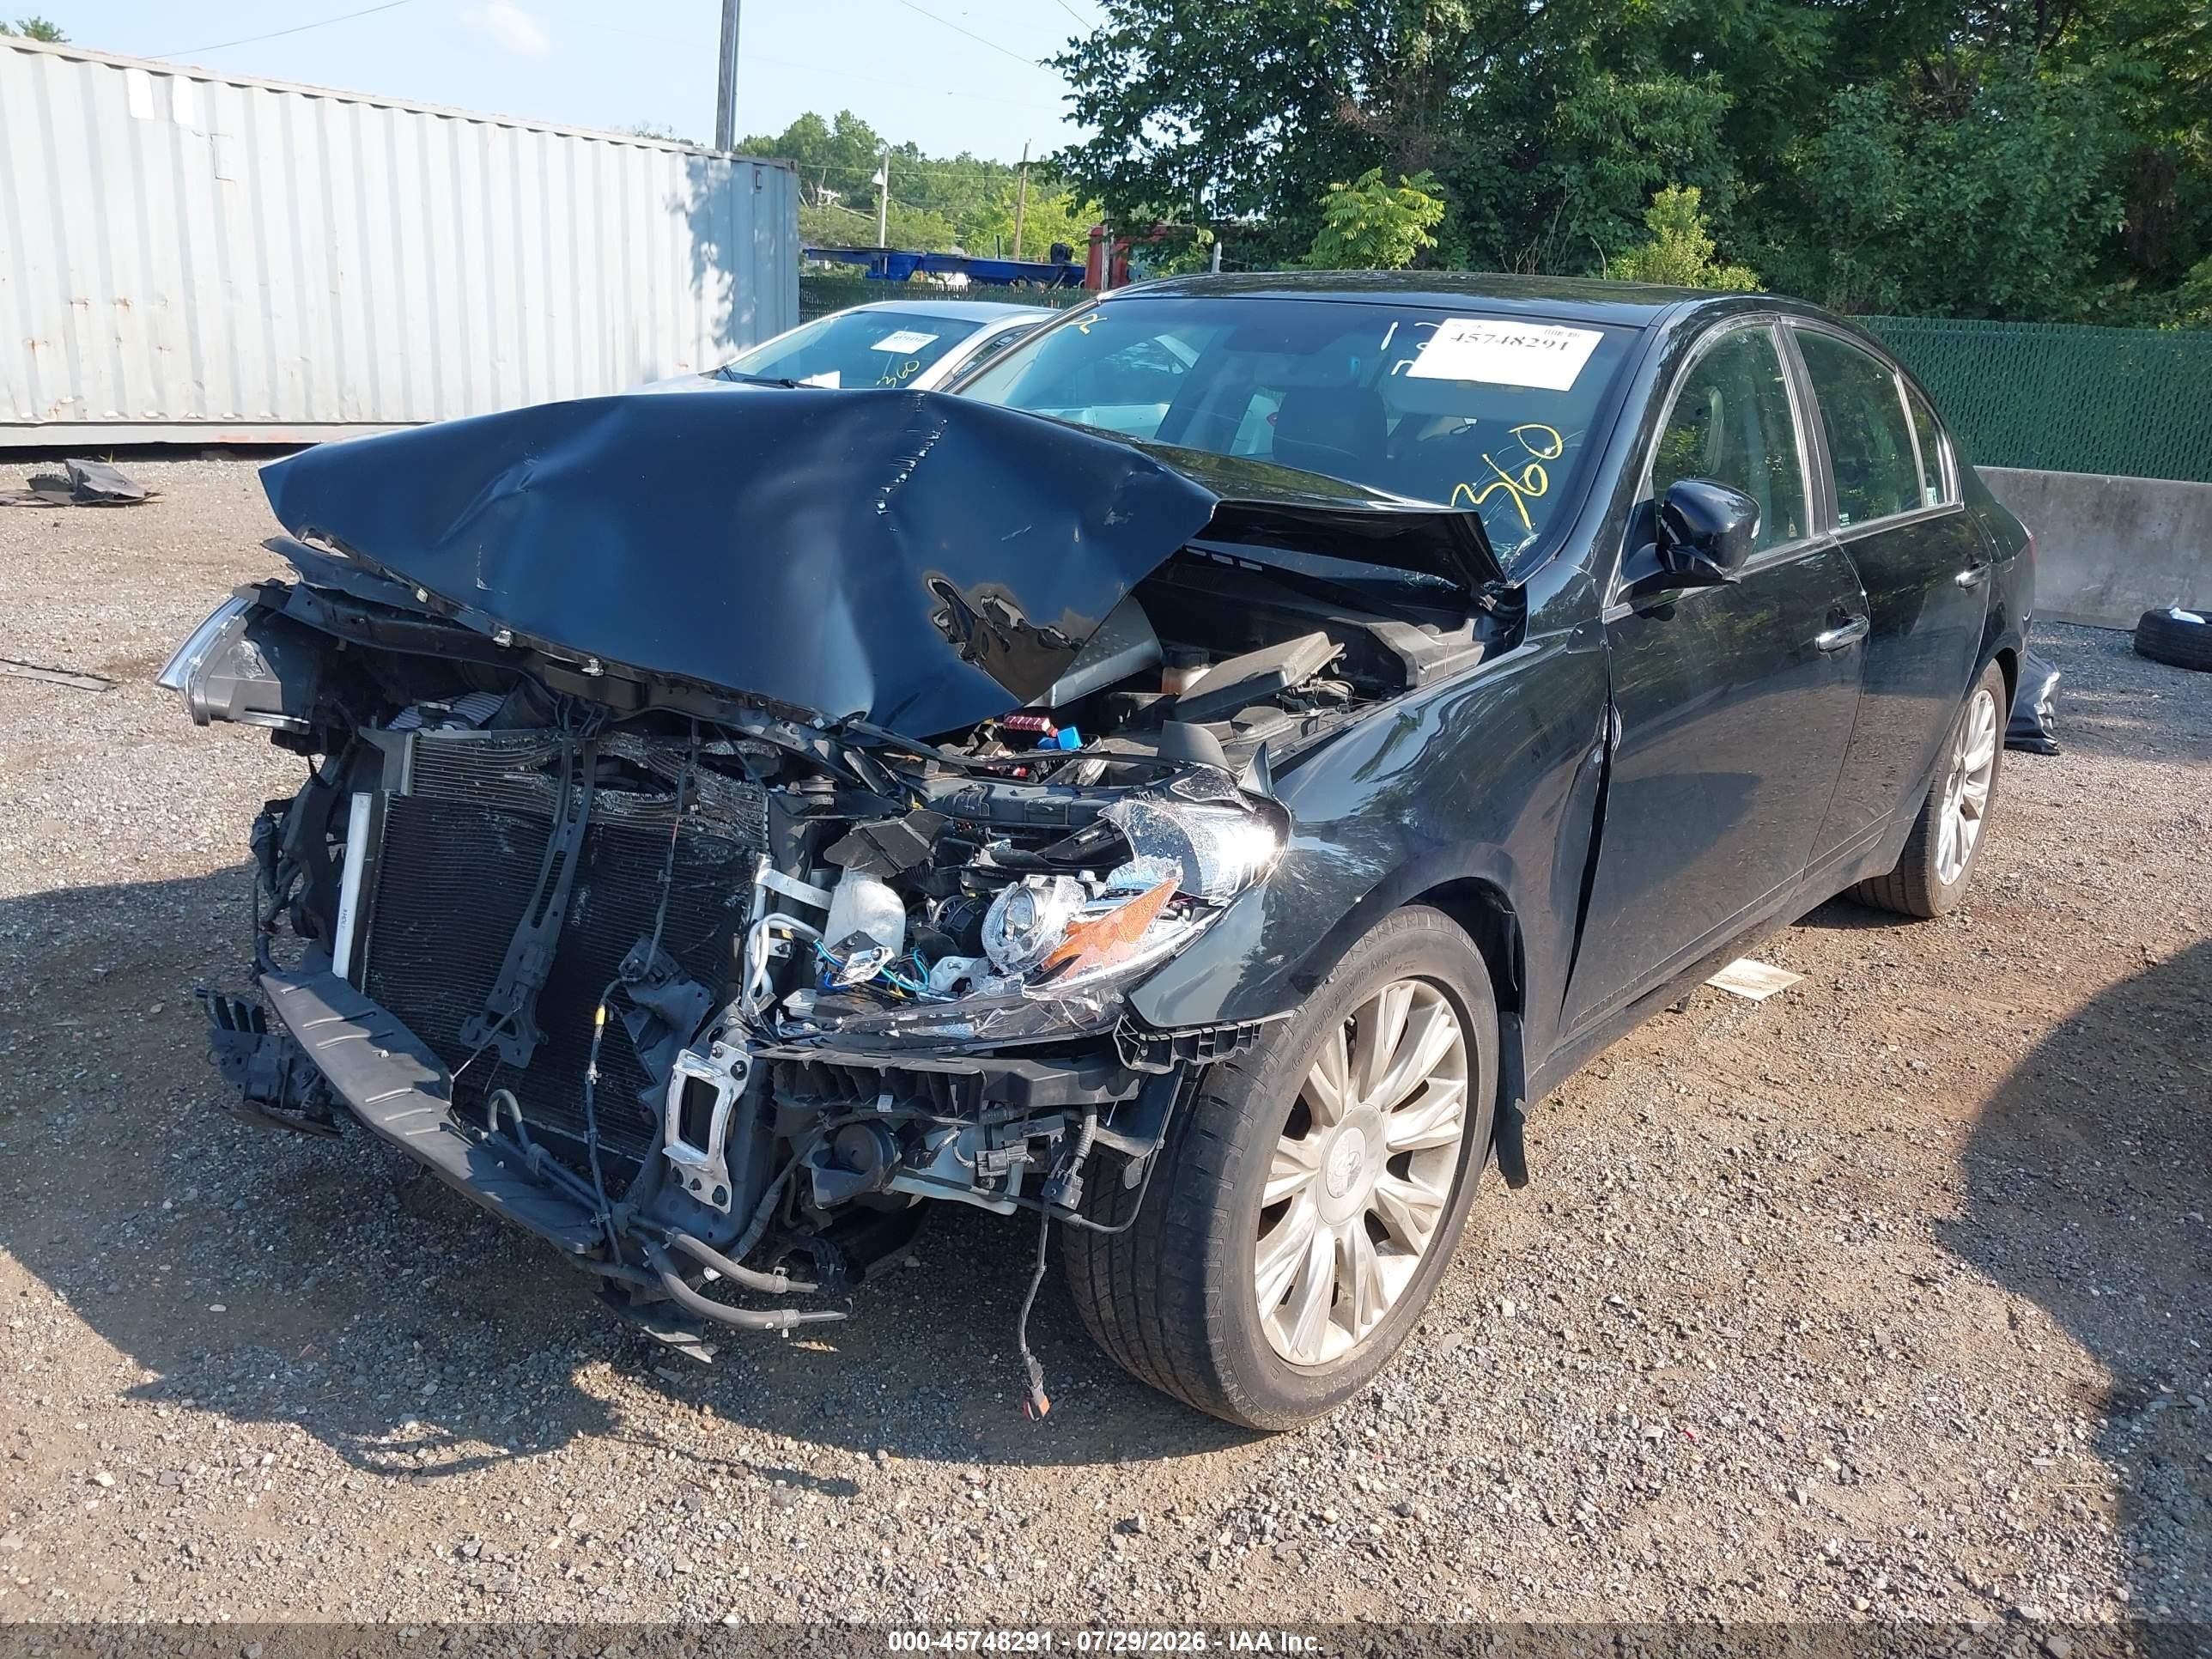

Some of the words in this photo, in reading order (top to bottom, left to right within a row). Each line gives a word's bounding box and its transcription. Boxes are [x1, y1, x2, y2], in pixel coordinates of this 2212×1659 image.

[1450, 331, 1570, 351] 45748291
[876, 360, 920, 388] 360
[1450, 423, 1564, 530] 360
